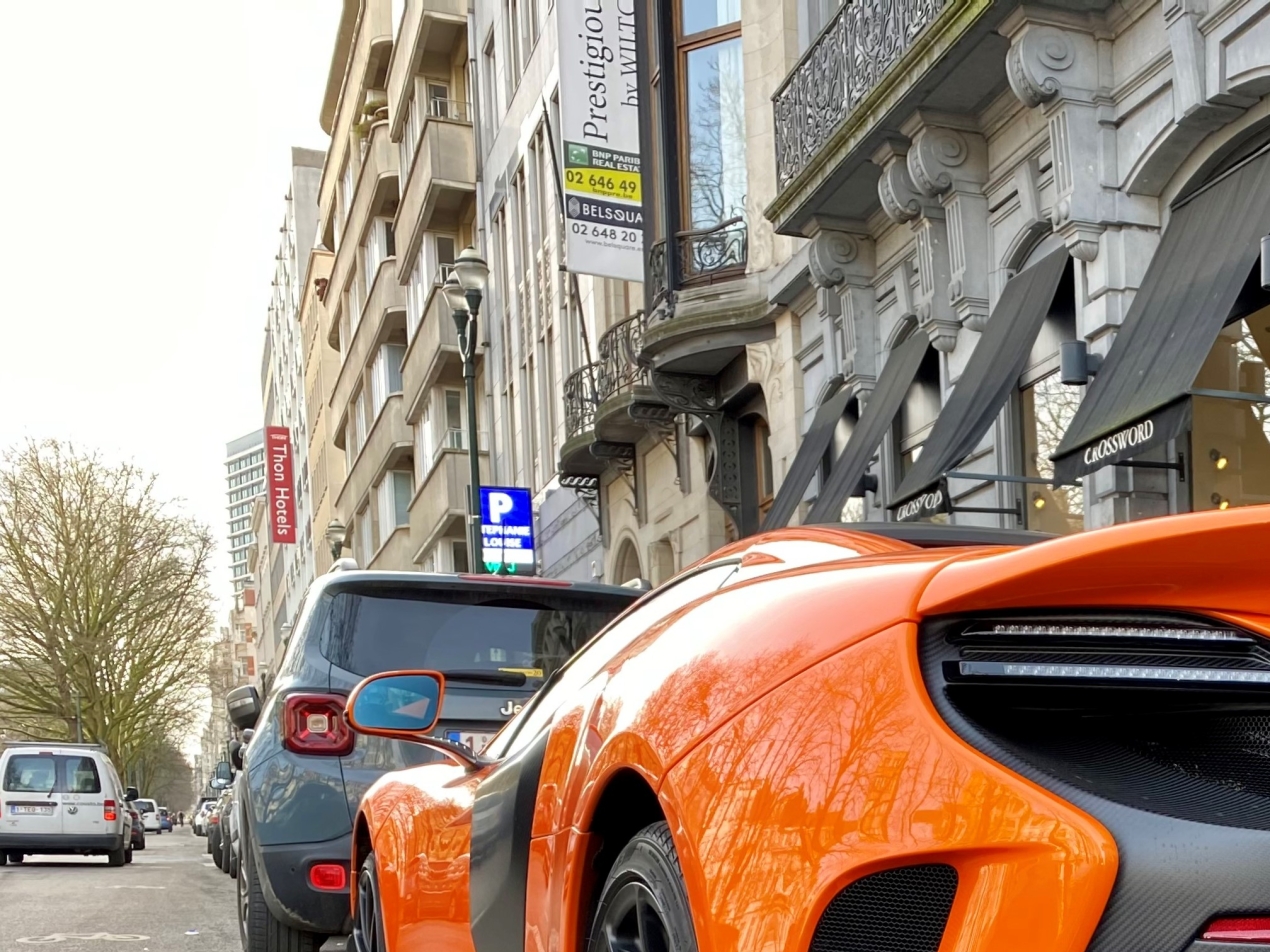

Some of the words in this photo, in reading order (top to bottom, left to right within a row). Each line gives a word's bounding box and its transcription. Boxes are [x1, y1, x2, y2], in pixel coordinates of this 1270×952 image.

[592, 149, 612, 160] BNP
[613, 154, 640, 165] PARIB
[592, 158, 616, 169] REAL
[617, 162, 641, 173] ESTA
[566, 170, 583, 185] 02
[589, 174, 614, 190] 646
[619, 180, 637, 194] 49
[582, 203, 643, 223] BELSQUA
[572, 222, 588, 236] 02
[592, 226, 617, 240] 648
[621, 230, 637, 243] 20
[1084, 419, 1154, 465] CROSSWORD
[272, 444, 287, 482] Thon
[275, 487, 291, 535] Hotels
[489, 492, 513, 524] P
[500, 701, 523, 715] Je
